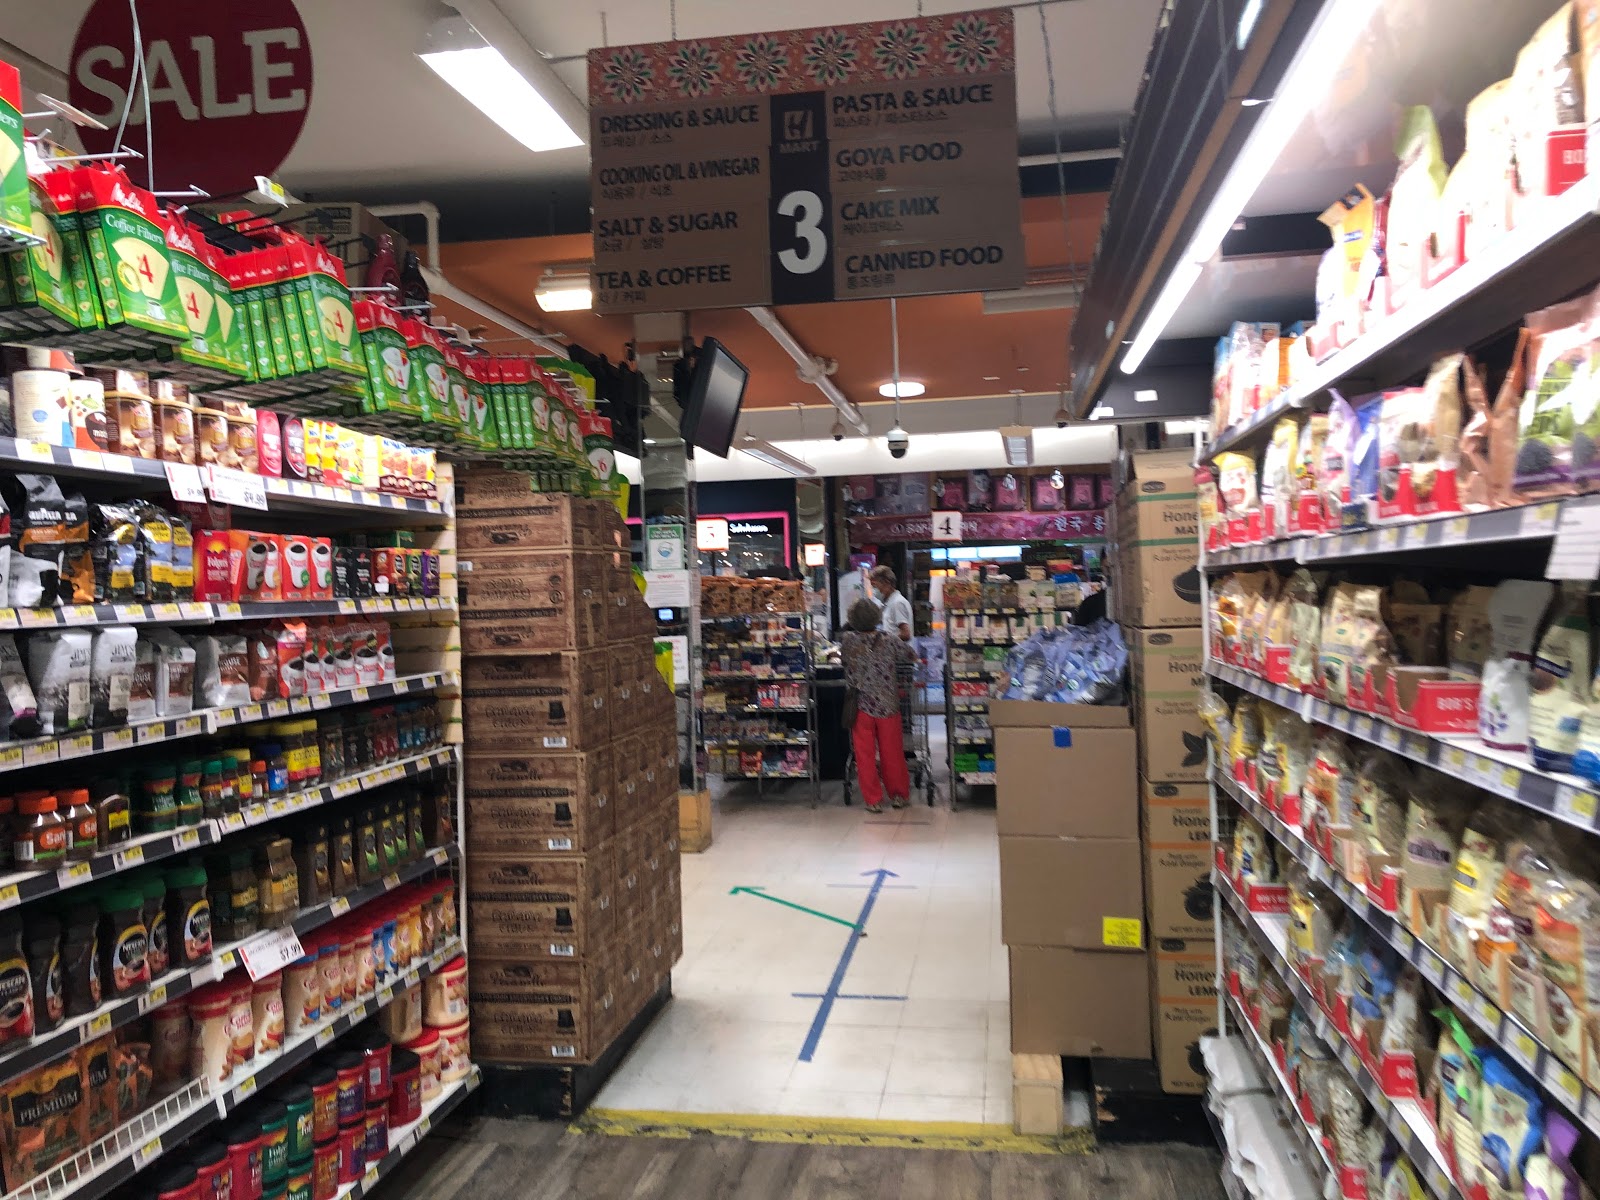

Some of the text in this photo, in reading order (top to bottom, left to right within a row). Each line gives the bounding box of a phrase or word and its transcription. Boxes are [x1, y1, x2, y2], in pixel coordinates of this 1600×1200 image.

[76, 27, 306, 129] SALE
[833, 84, 993, 114] PASTA & SAUCE
[599, 105, 759, 134] DRESSING & SAUCE
[836, 141, 962, 168] GOYA FOOD
[600, 157, 760, 186] COOKING OIL & VINEGAR
[840, 196, 940, 221] CAKE MIX
[105, 213, 164, 245] Coffee Filters
[598, 211, 738, 237] SALT & SUGAR
[777, 190, 827, 274] 3
[137, 254, 154, 284] 4
[846, 245, 1003, 274] CANNED FOOD
[596, 265, 731, 289] TEA & COFFEE
[186, 291, 200, 319] 4
[333, 310, 345, 334] 4
[939, 516, 953, 535] 4
[1163, 510, 1199, 522] Hone
[1175, 526, 1199, 535] MAT
[1168, 661, 1202, 673] Hone
[1172, 815, 1210, 827] Hone
[20, 1090, 78, 1124] PREMIUM
